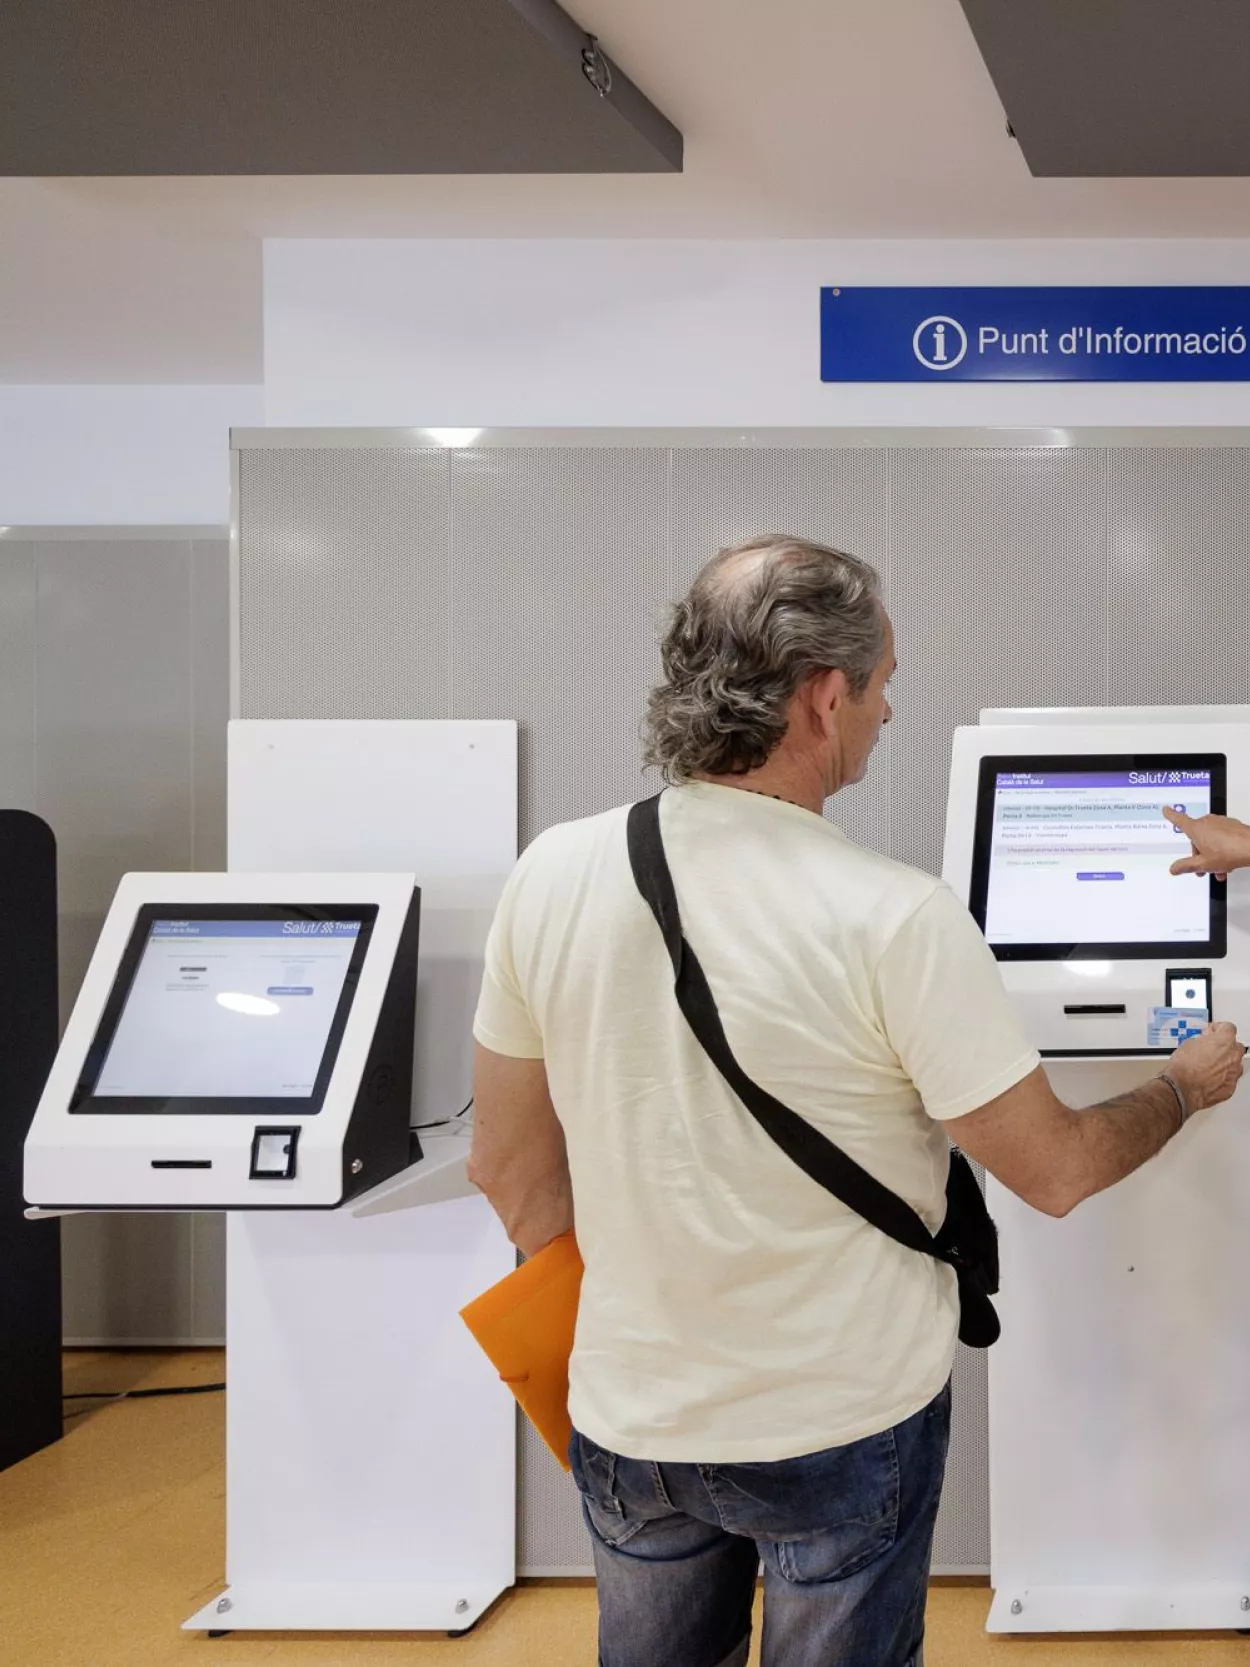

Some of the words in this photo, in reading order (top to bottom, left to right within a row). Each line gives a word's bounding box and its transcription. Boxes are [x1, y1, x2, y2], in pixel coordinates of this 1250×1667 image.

[979, 326, 1047, 354] Punt
[1058, 324, 1245, 354] d'Informació
[1128, 772, 1167, 784] Salut/
[282, 921, 321, 934] Salut/
